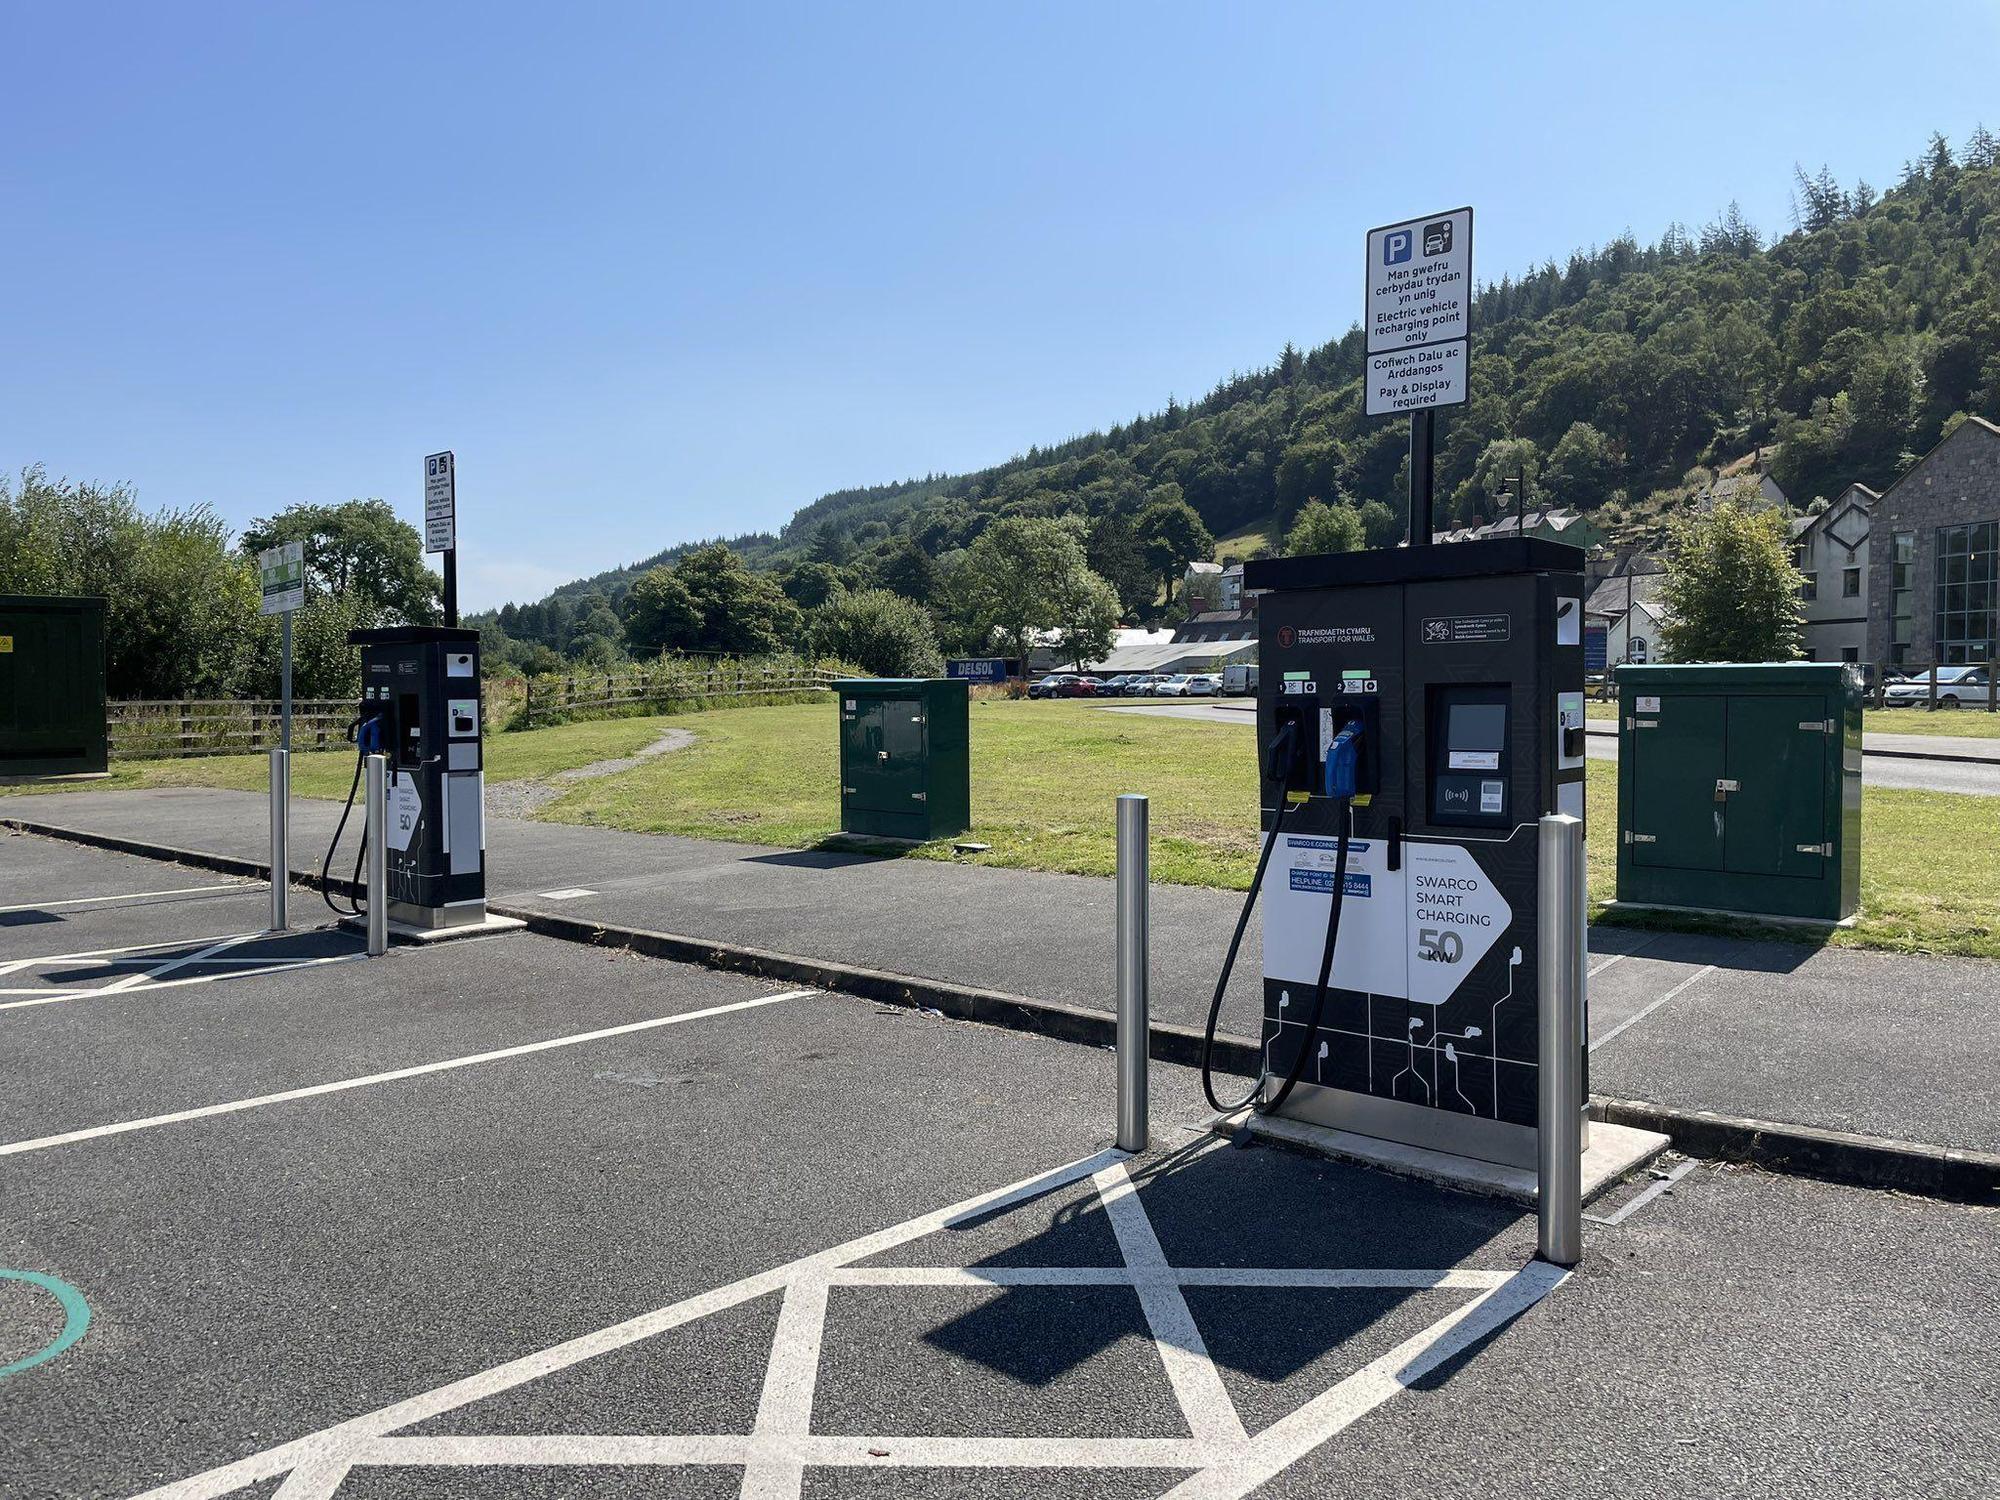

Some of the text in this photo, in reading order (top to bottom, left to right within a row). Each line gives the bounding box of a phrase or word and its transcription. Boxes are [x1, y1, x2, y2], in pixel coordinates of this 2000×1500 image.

[1389, 234, 1407, 262] P
[1388, 261, 1449, 281] Man gwefru
[1375, 270, 1461, 296] cerbydau trydan
[1398, 288, 1436, 306] yn unig
[1377, 300, 1458, 323] Electric vehicle
[1375, 312, 1460, 336] recharging point
[1405, 330, 1428, 343] only
[1374, 348, 1459, 370] Cofiwch Dalu ac
[1387, 363, 1444, 380] Arddangos
[1380, 379, 1451, 398] Pay & Display
[1393, 392, 1436, 409] required
[1298, 627, 1371, 637] TRAFNIDIAETH CYMRU
[1298, 634, 1375, 644] TRANSPORT FOR WALES
[958, 662, 993, 675] DELSOL
[400, 814, 411, 831] 50
[1291, 877, 1323, 886] HELPLINE
[1416, 875, 1478, 891] SWARCO
[1416, 892, 1464, 907] SMART
[1416, 908, 1491, 927] CHARGING
[1417, 928, 1464, 964] 50
